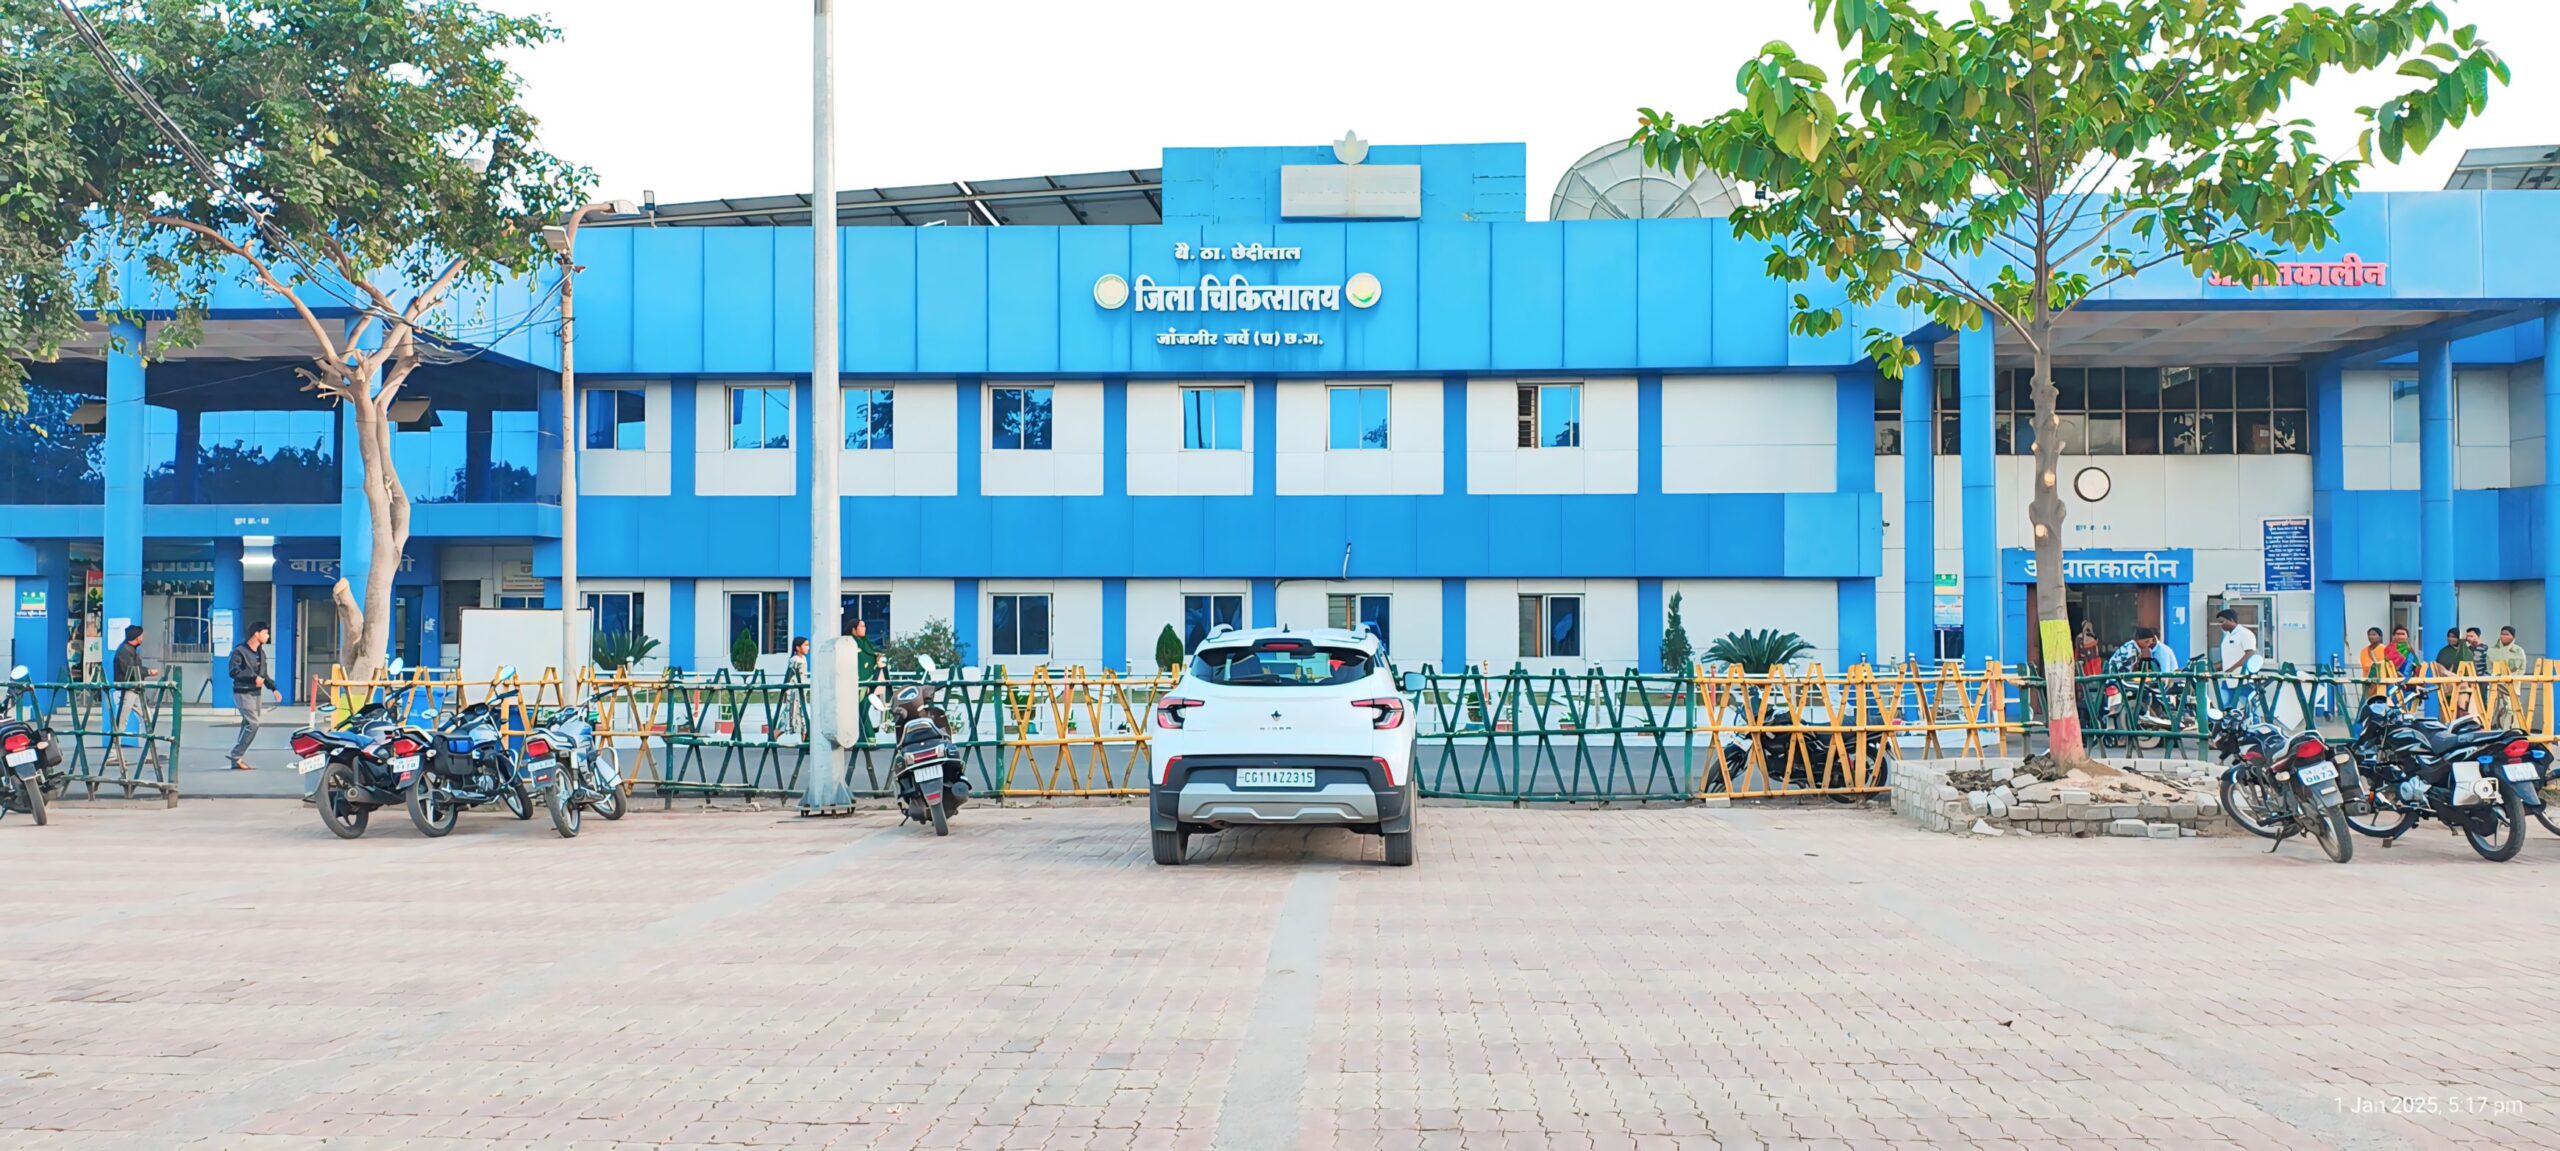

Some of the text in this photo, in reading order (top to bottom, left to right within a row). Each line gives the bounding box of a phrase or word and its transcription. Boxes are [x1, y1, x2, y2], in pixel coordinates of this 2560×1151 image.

[1199, 247, 1226, 260] ठा.
[1231, 242, 1301, 261] छेदीलाल
[1134, 273, 1341, 311] जिला चिकित्सालय
[1244, 771, 1313, 784] CG11AZ2315
